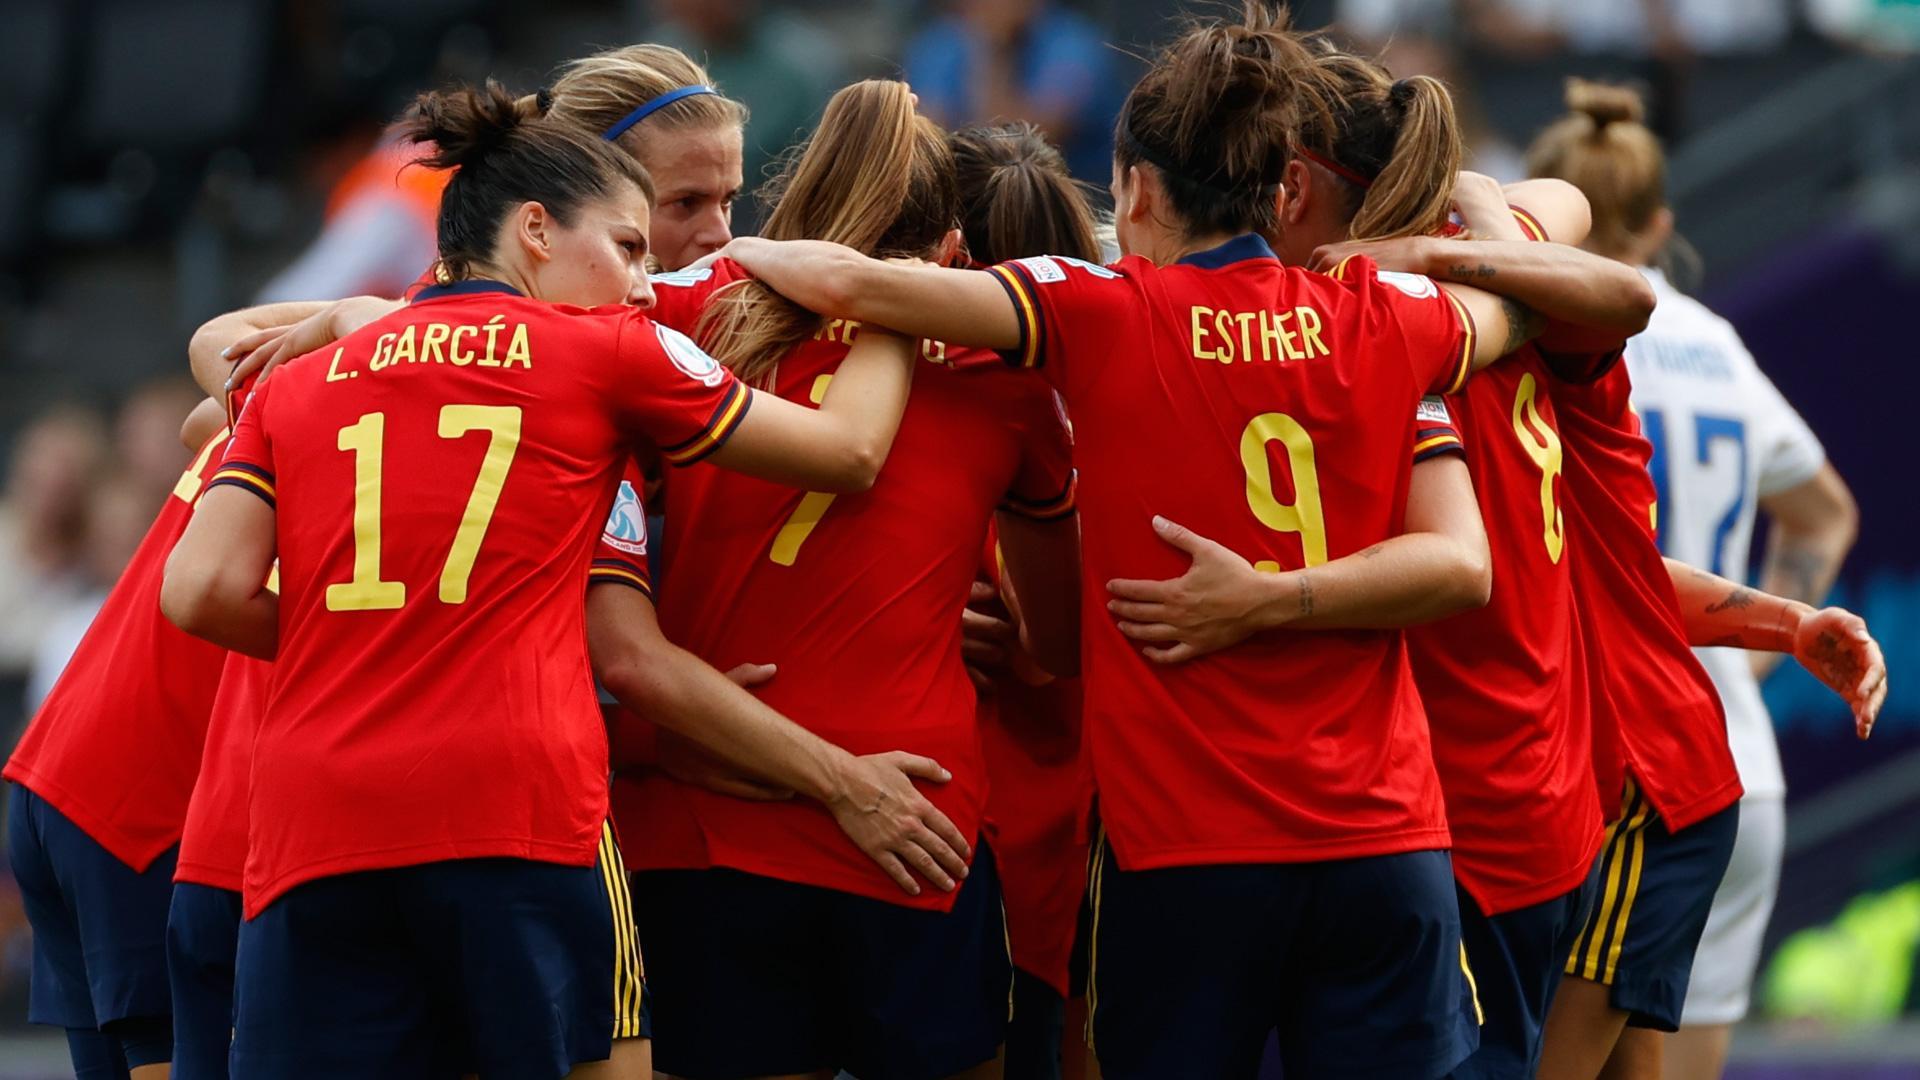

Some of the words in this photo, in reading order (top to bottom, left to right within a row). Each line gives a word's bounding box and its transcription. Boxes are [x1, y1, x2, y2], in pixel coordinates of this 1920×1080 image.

[325, 346, 359, 383] L.
[369, 315, 531, 371] GARCÍA
[1190, 305, 1329, 364] ESTHER
[325, 404, 523, 612] 17
[1239, 412, 1328, 573] 9
